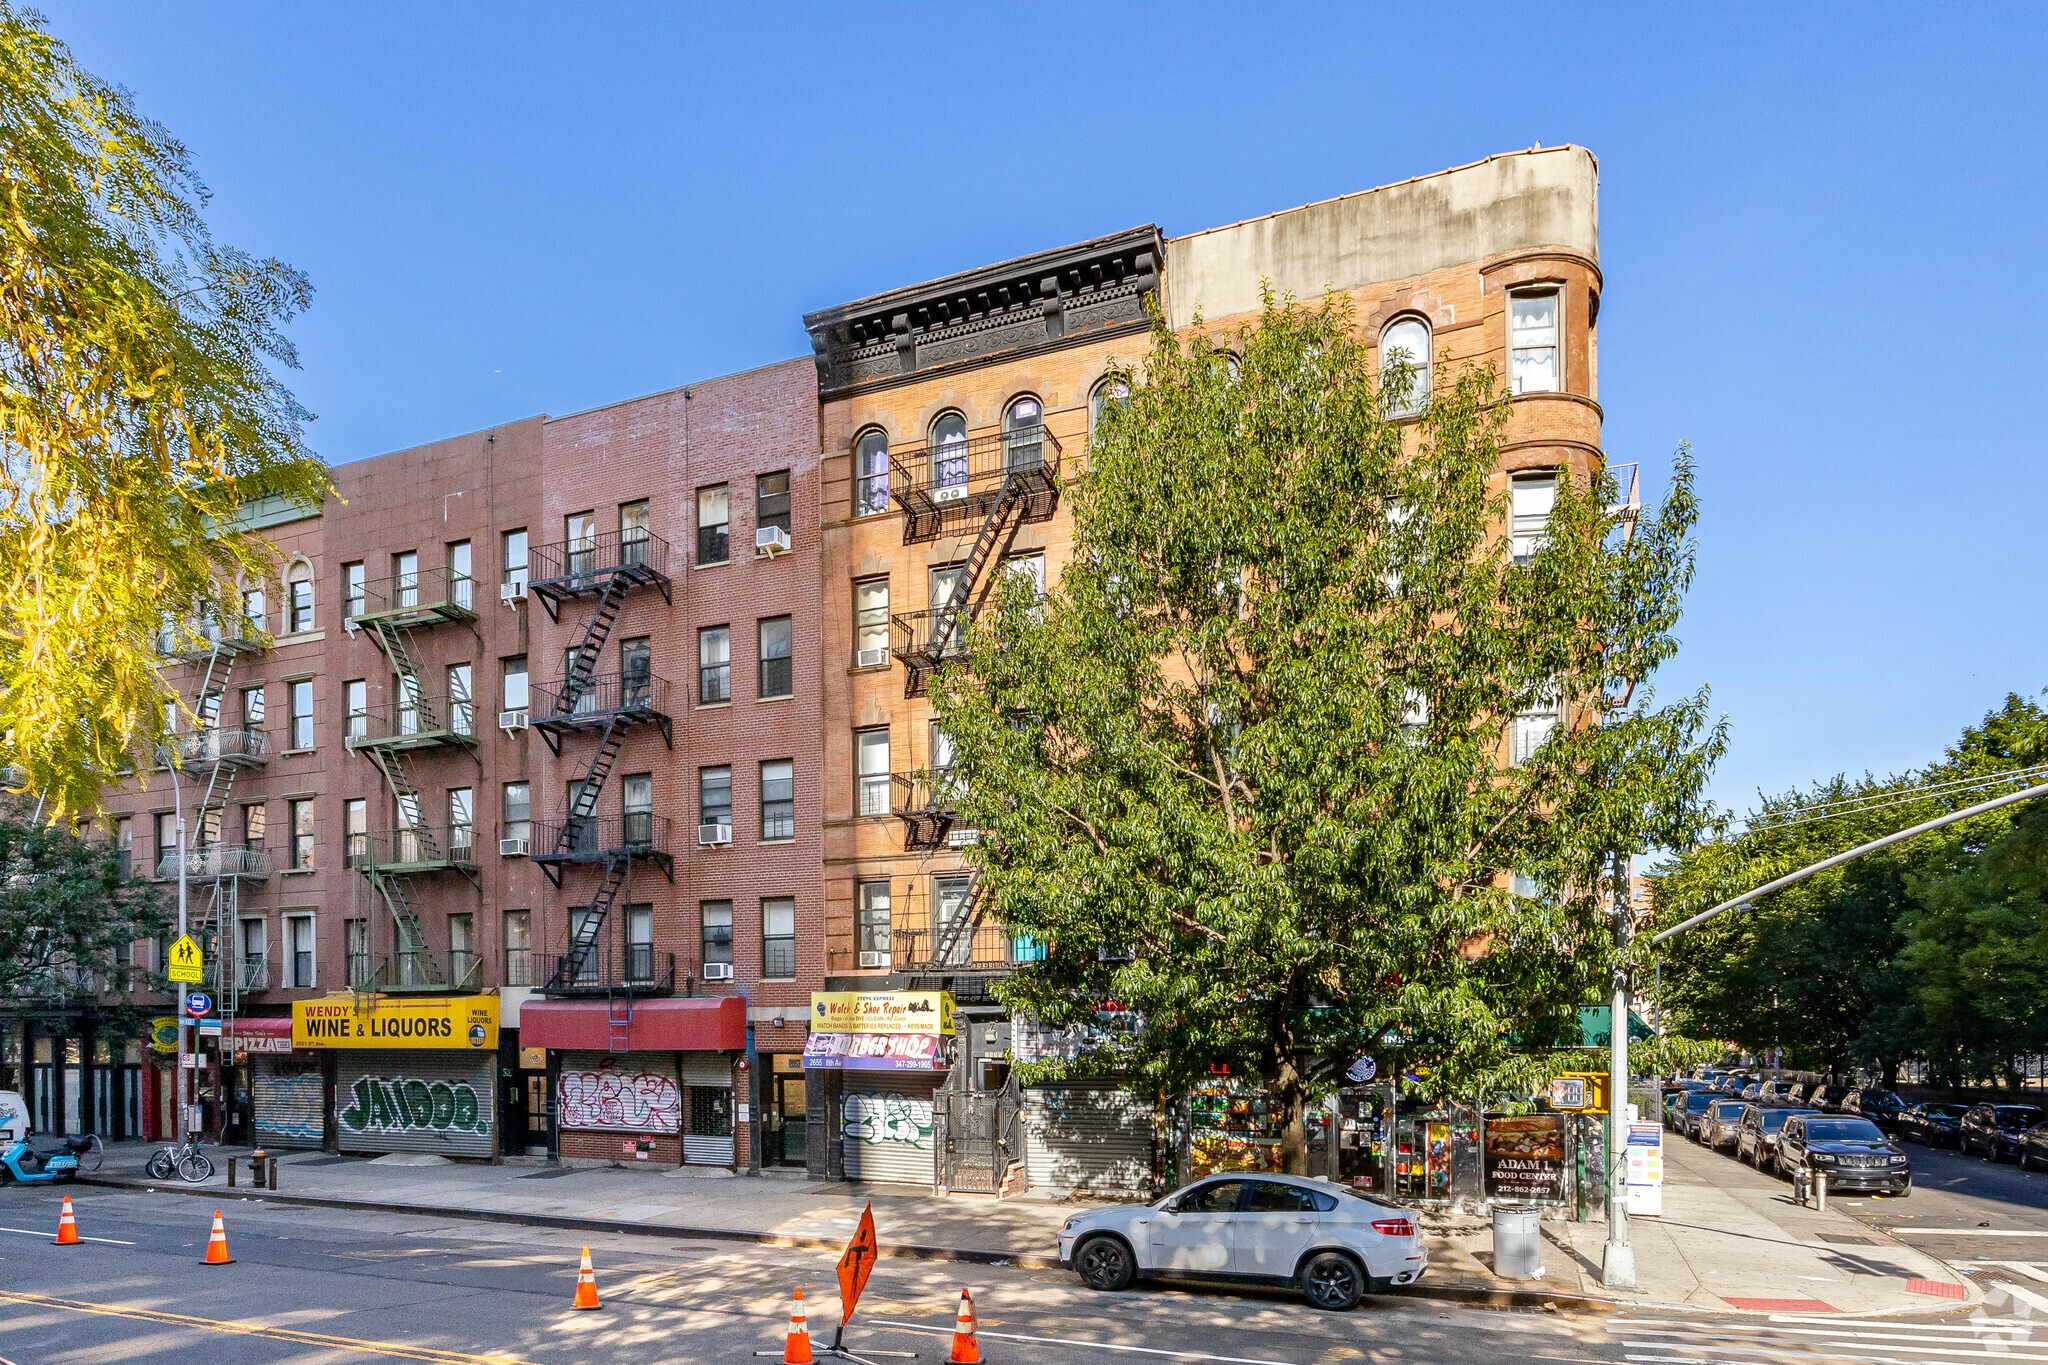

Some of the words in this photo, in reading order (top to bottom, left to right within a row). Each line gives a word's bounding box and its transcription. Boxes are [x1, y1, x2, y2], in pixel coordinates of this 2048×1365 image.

[172, 971, 200, 979] SCHOOL
[830, 1002, 851, 1014] Watch
[854, 1002, 860, 1014] &
[863, 1002, 880, 1014] Shoe
[883, 1001, 907, 1017] Repair
[467, 1016, 492, 1024] LIQUORS
[306, 1019, 350, 1037] WINE
[356, 1023, 365, 1037] &
[371, 1017, 452, 1038] LIQUORS
[234, 1037, 276, 1051] PIZZA
[1498, 1159, 1541, 1170] ADAM
[1492, 1171, 1517, 1179] FOOD
[1519, 1172, 1557, 1181] CENTER
[1498, 1185, 1551, 1194] 212-862-2657
